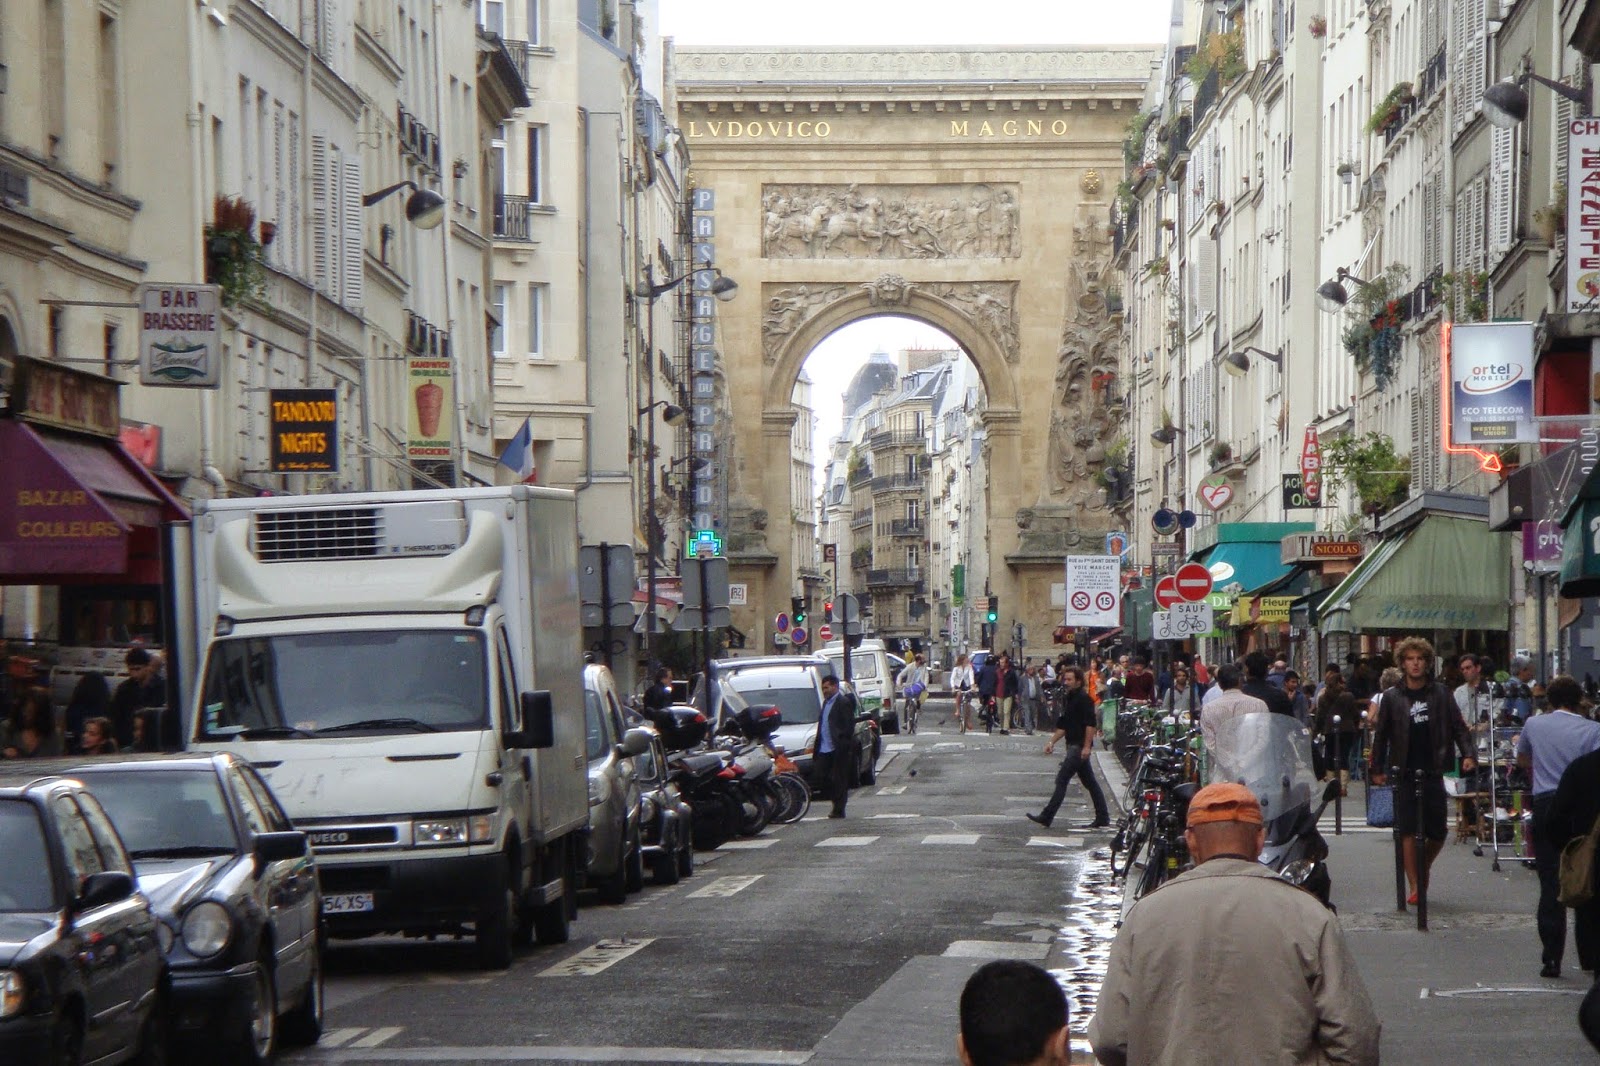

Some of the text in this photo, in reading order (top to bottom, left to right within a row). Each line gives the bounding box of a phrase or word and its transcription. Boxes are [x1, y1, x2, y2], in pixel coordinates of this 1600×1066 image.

[689, 119, 1068, 138] LVDOVICO MAGNO
[161, 290, 198, 307] BAR
[144, 312, 215, 331] BRASSERIE
[1472, 363, 1510, 375] ortel
[273, 401, 337, 422] TANDOORI
[1461, 406, 1524, 415] ECO TELECOM
[279, 432, 327, 454] NIGHTS
[1303, 429, 1319, 497] TABAC
[18, 490, 88, 506] BAZAR
[17, 521, 121, 538] COULEURS
[1316, 545, 1358, 554] NICOLAS
[1100, 597, 1110, 606] 15
[1178, 605, 1205, 613] SAUF
[1160, 613, 1170, 621] SA
[308, 832, 349, 843] IVECO
